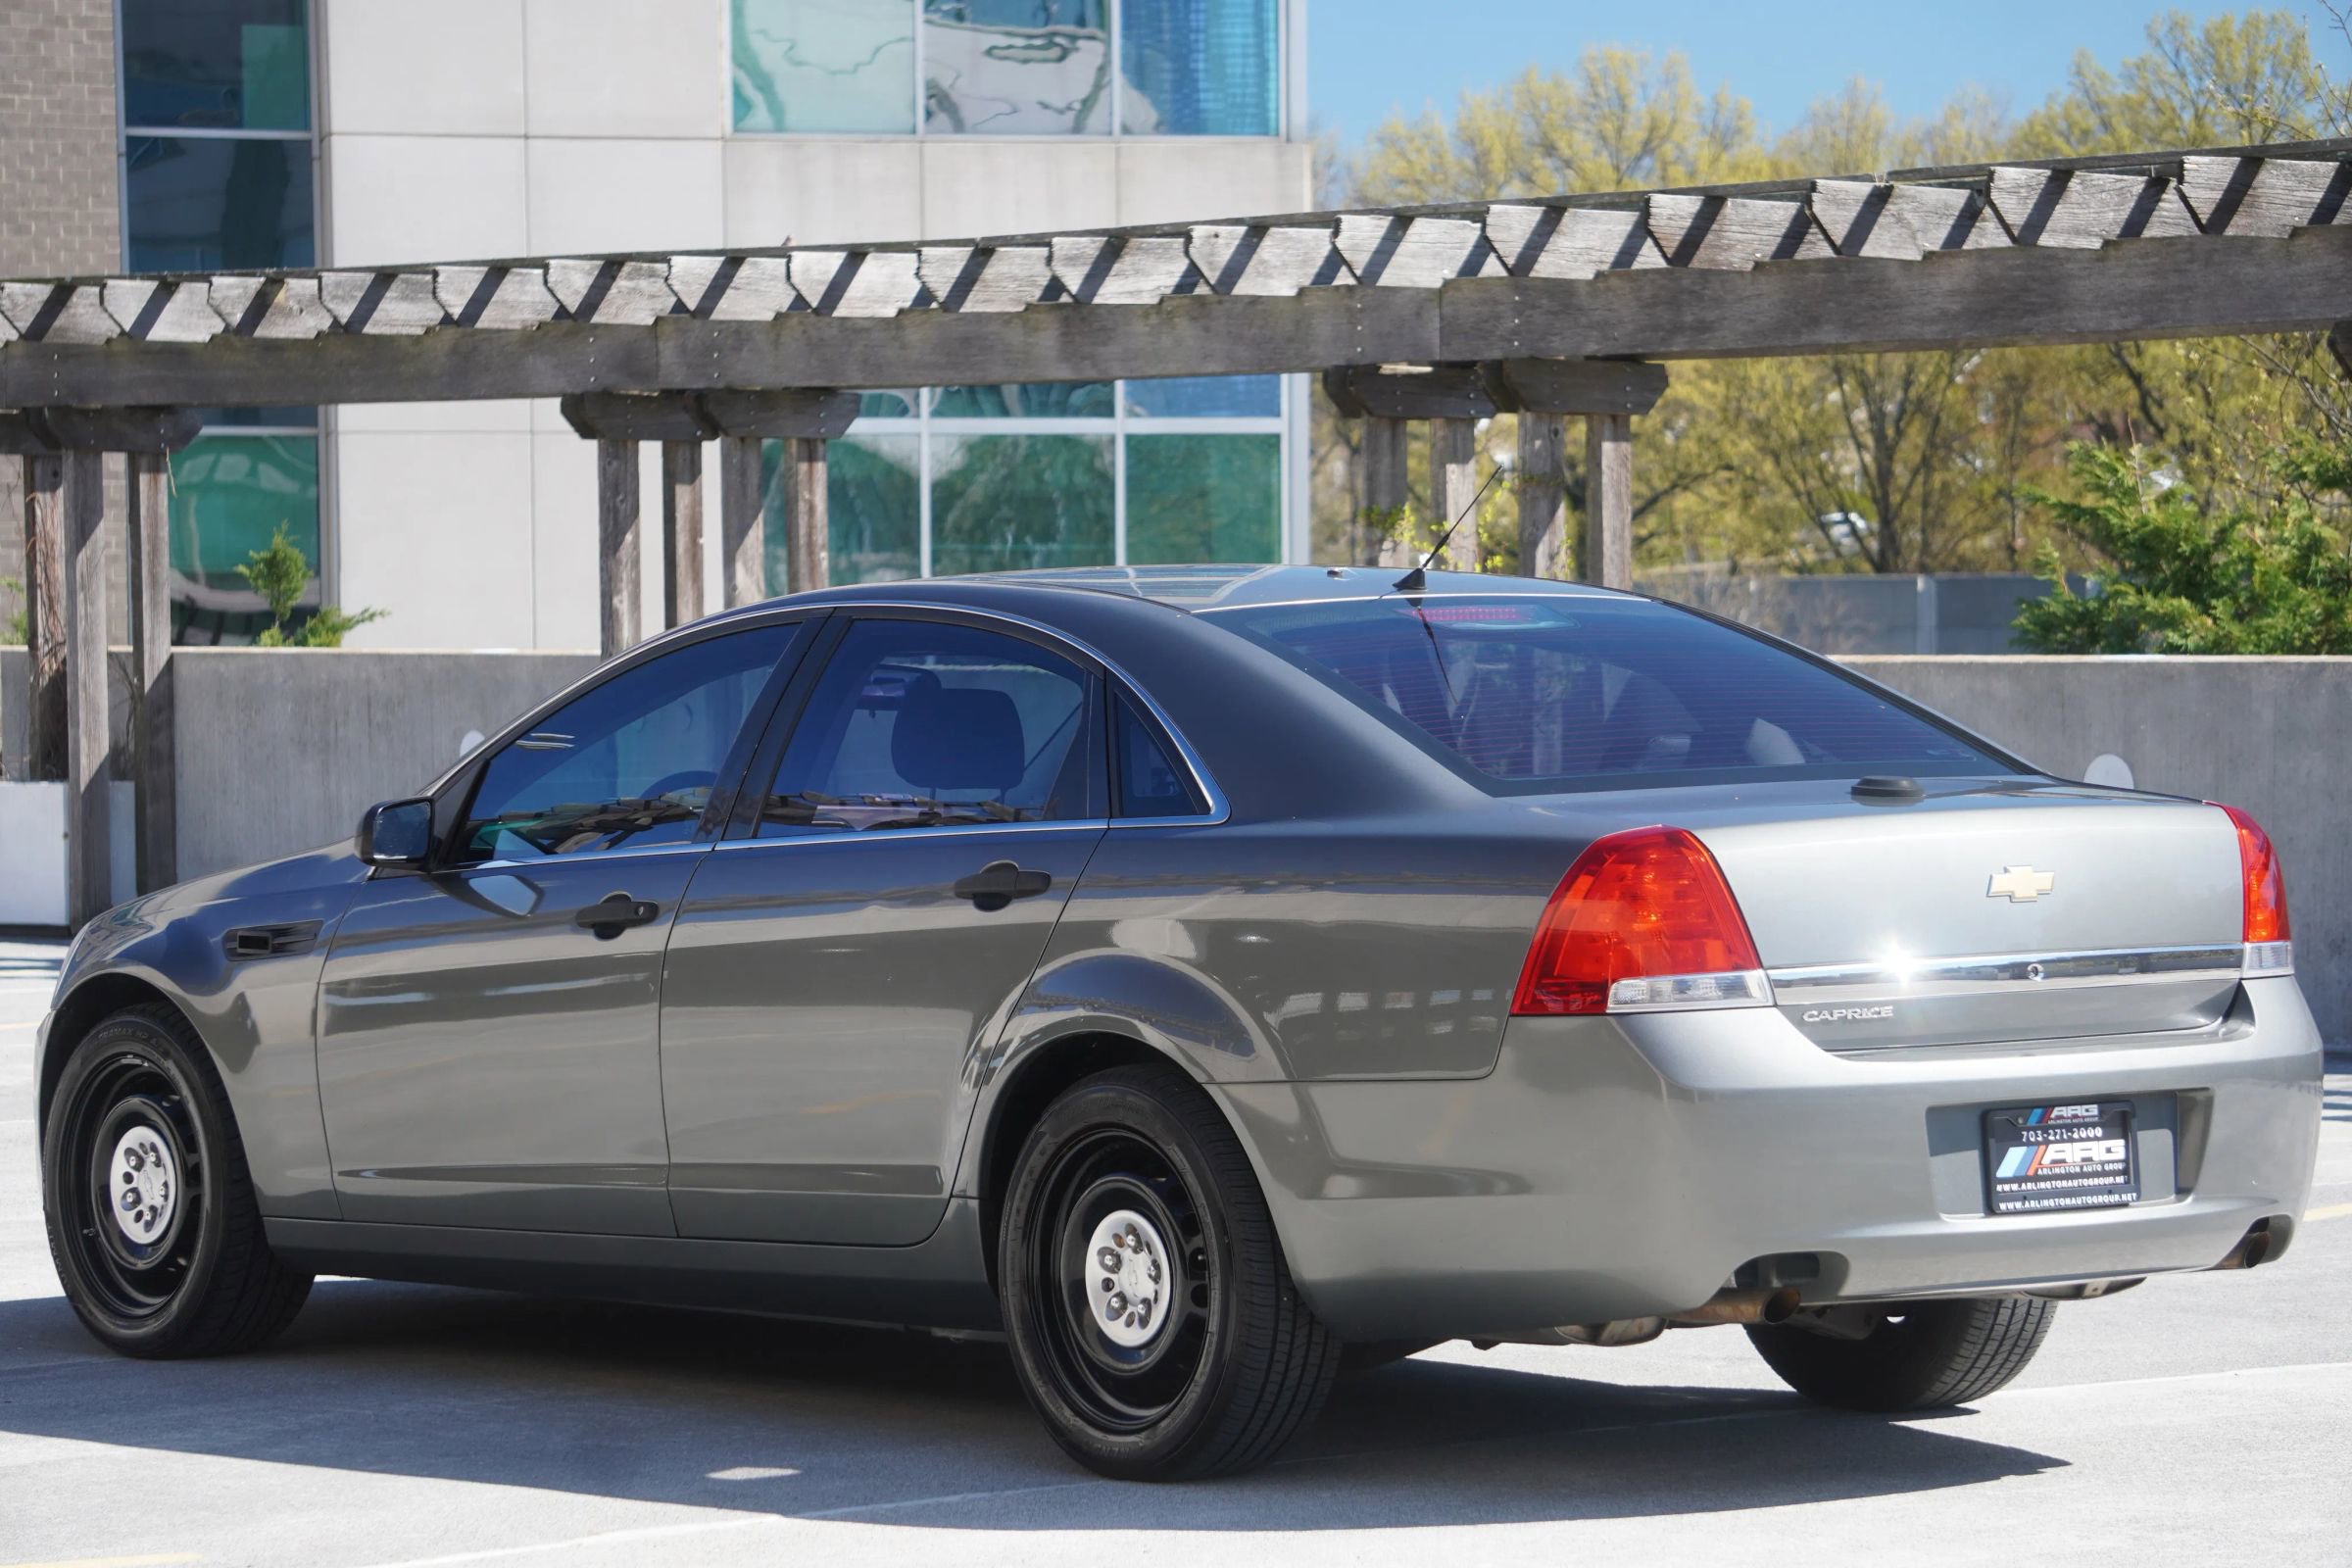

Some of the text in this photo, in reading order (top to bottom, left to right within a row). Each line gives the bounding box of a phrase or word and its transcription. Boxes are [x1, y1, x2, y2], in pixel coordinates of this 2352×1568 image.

[1802, 1005, 1894, 1022] CAPRICE
[2022, 1127, 2102, 1142] 703-271-2000
[2037, 1164, 2082, 1175] ARLINGTON
[2082, 1163, 2102, 1173] AUTO
[1998, 1193, 2137, 1210] WWW.ARLINGTONAUTOGROUP.NET
